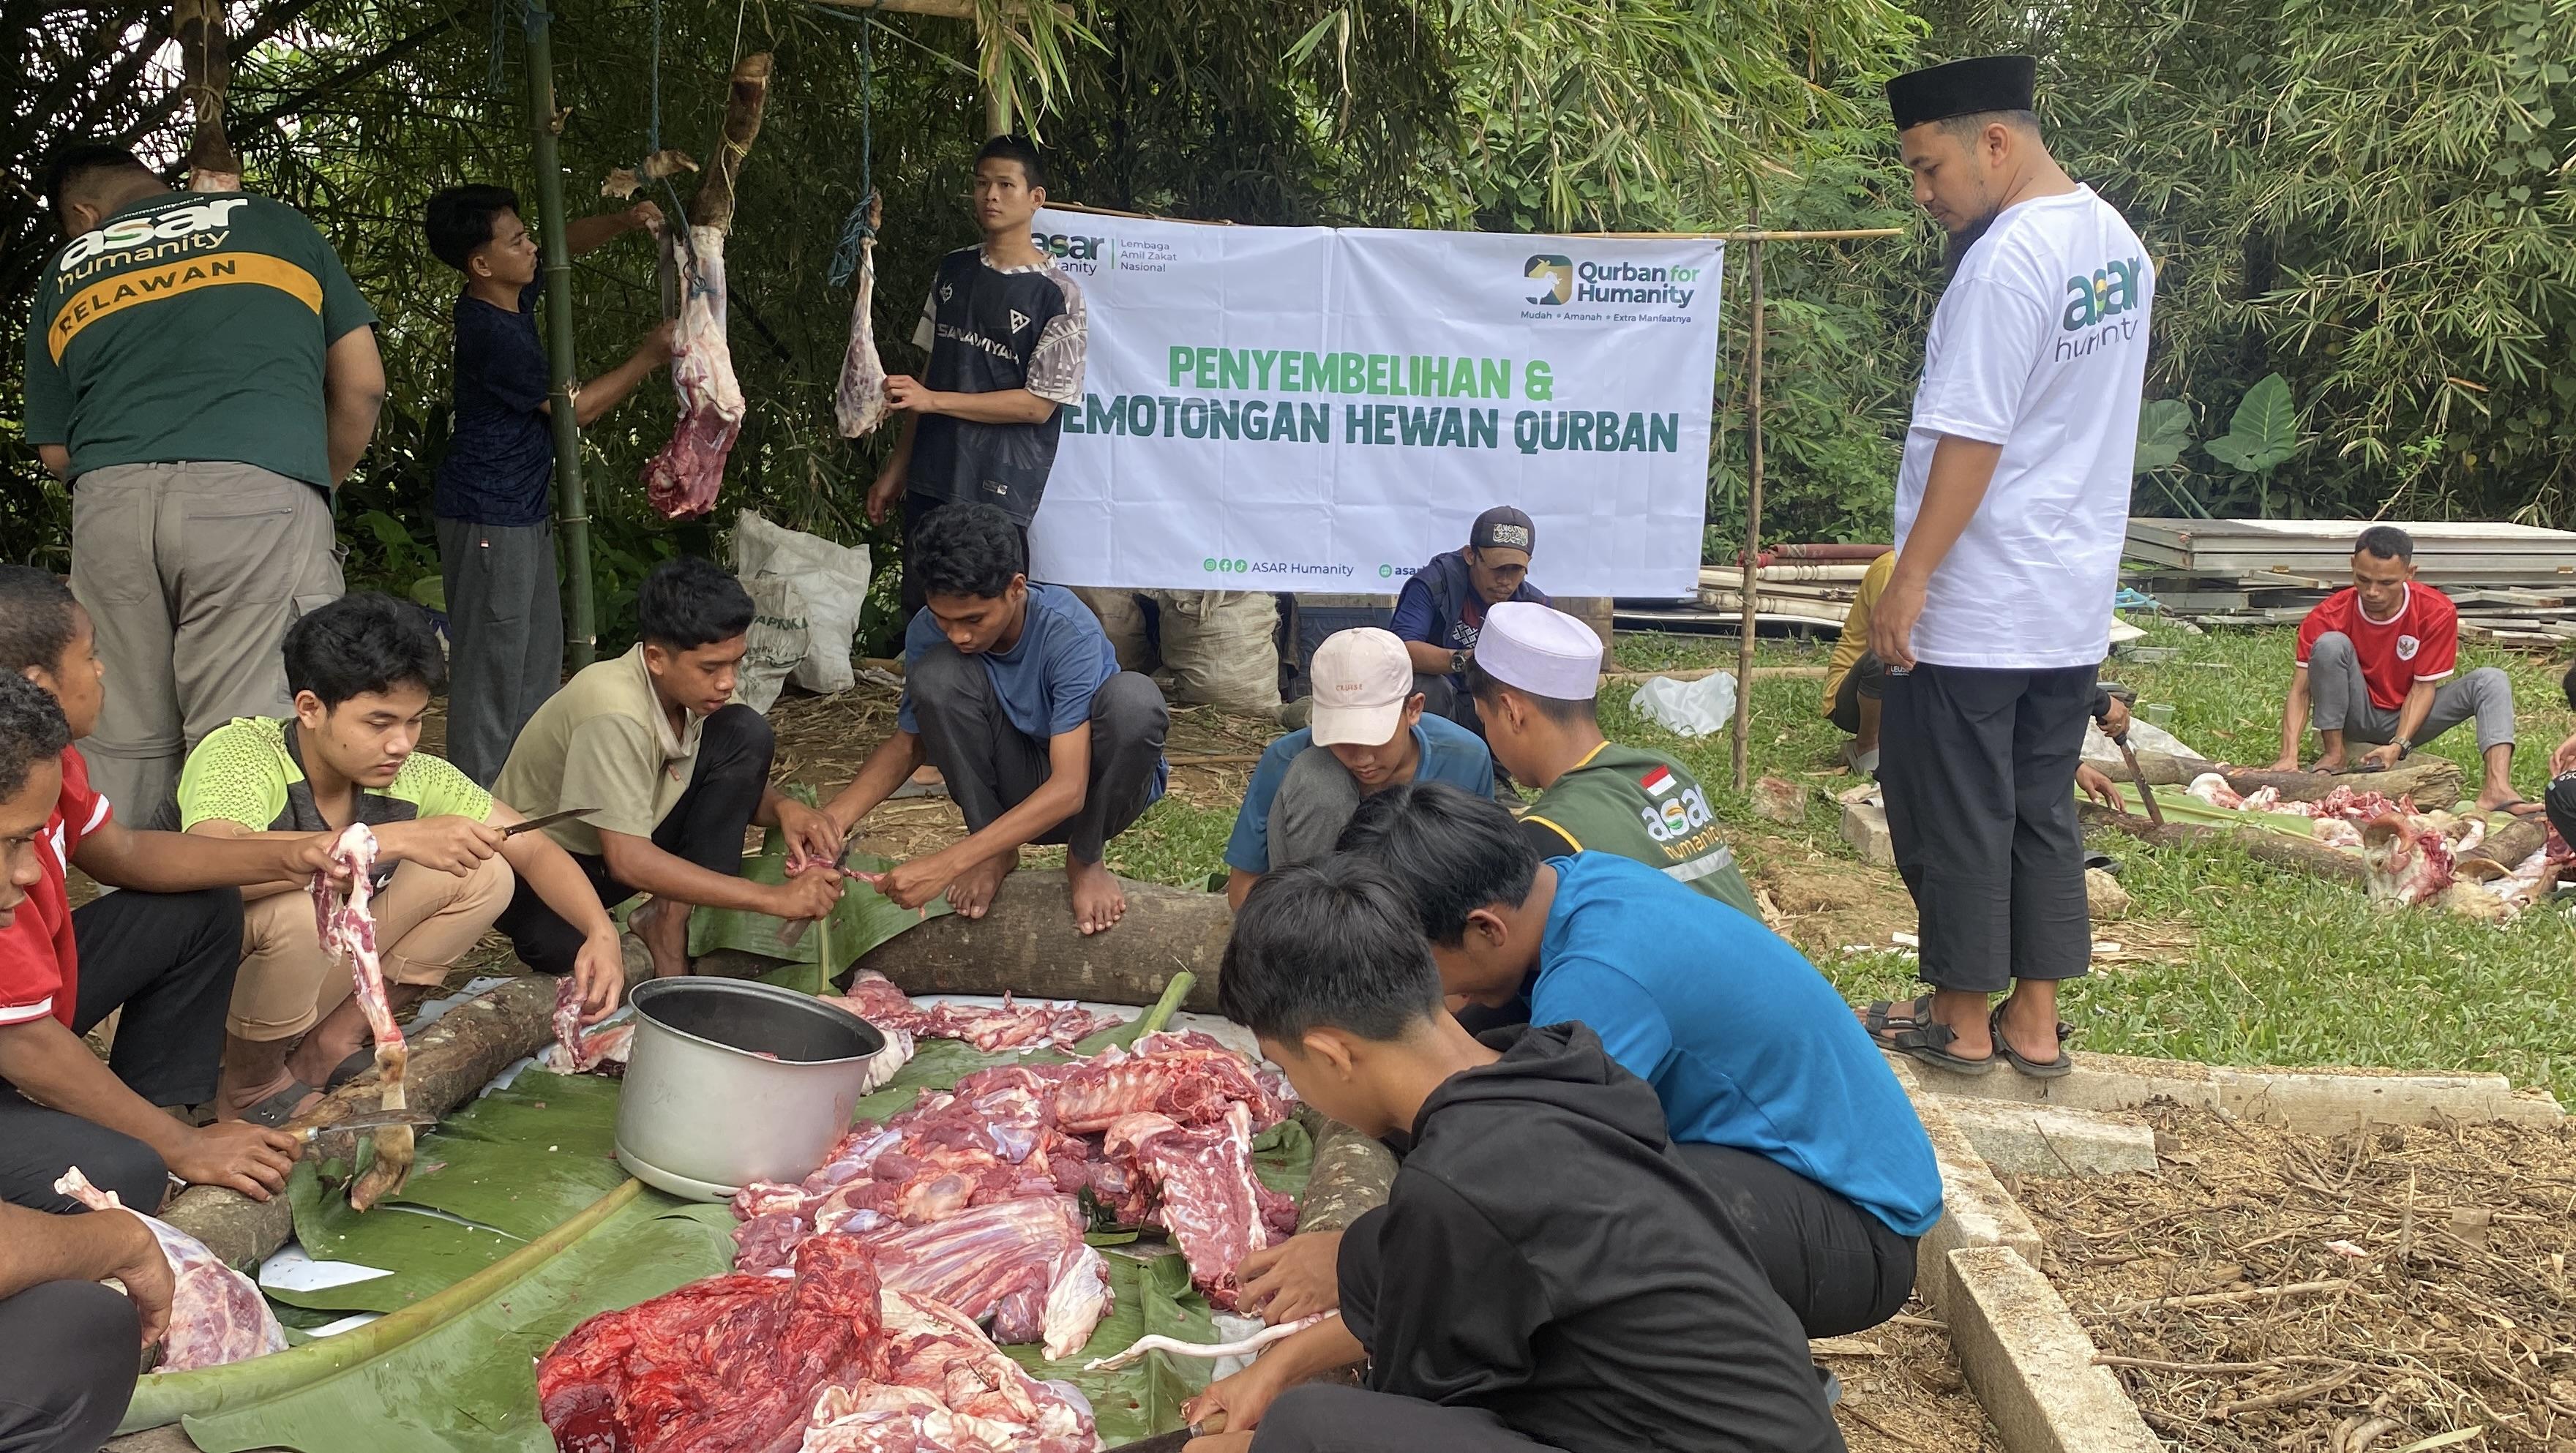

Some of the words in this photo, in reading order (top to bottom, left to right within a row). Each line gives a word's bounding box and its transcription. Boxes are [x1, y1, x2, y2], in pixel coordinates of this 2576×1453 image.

[60, 198, 248, 272] asar
[1120, 239, 1170, 251] Lembaga
[1120, 249, 1145, 259] Amil
[1146, 251, 1177, 261] Zakat
[1061, 260, 1098, 277] anity
[1120, 261, 1166, 273] Nasional
[1578, 261, 1666, 284] Qurban
[1669, 264, 1700, 282] for
[58, 259, 236, 337] RELAWAN
[1577, 283, 1695, 309] Humanity
[1521, 310, 1552, 320] Mudah
[1563, 312, 1602, 321] Amanah
[1614, 314, 1636, 323] Extra
[1639, 314, 1691, 325] Manfaatnya
[1169, 345, 1511, 399] PENYEMBELIHAN
[1524, 359, 1554, 402] &
[1063, 393, 1330, 444] EMOTONGAN
[1345, 403, 1499, 449] HEWAN
[1514, 410, 1679, 454] QURBAN
[1251, 562, 1287, 574] ASAR
[1291, 562, 1354, 577] Humanity
[1336, 683, 1363, 691] CRUISE
[1641, 783, 1713, 841] asar
